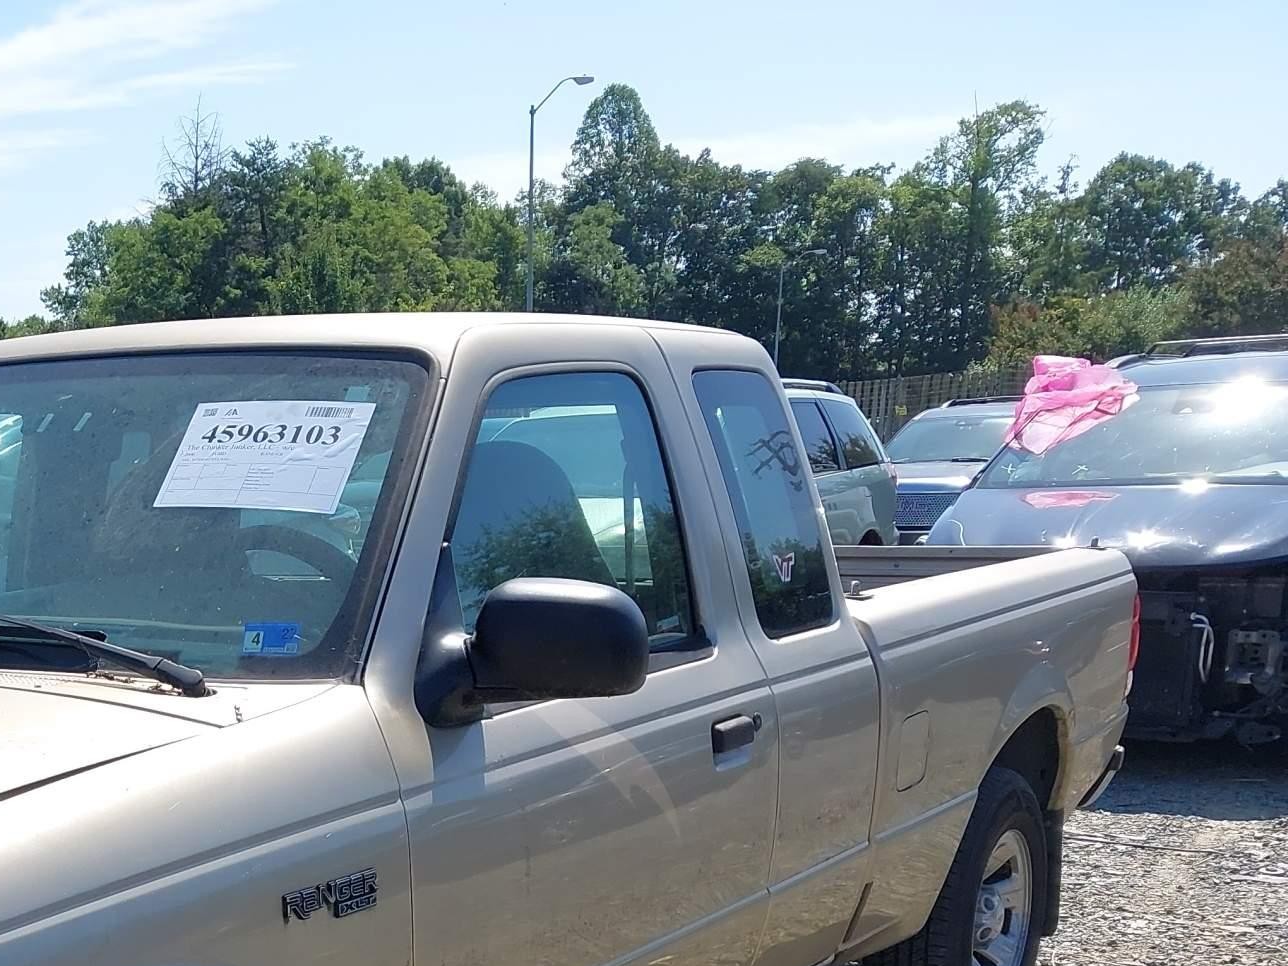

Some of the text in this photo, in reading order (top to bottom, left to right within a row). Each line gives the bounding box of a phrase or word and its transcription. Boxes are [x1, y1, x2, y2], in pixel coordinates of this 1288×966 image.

[201, 424, 342, 445] 45963103
[252, 632, 261, 646] 4
[282, 867, 377, 926] RANGER
[338, 894, 377, 918] XLT
